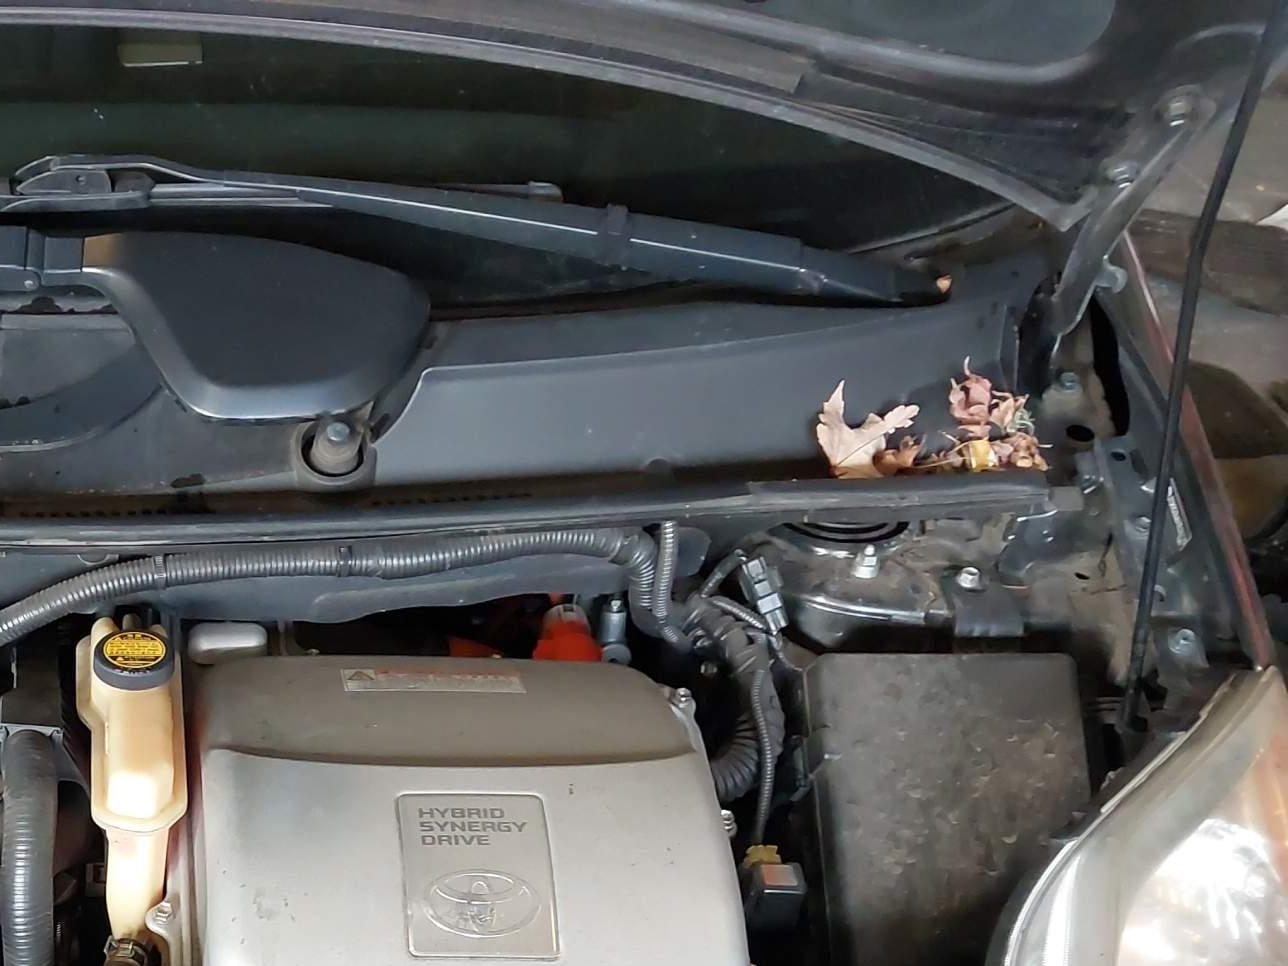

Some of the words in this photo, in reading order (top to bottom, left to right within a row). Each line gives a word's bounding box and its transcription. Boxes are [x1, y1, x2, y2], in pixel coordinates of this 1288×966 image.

[418, 807, 505, 819] HYBRID
[419, 821, 528, 833] SYNERGY
[421, 835, 491, 846] DRIVE
